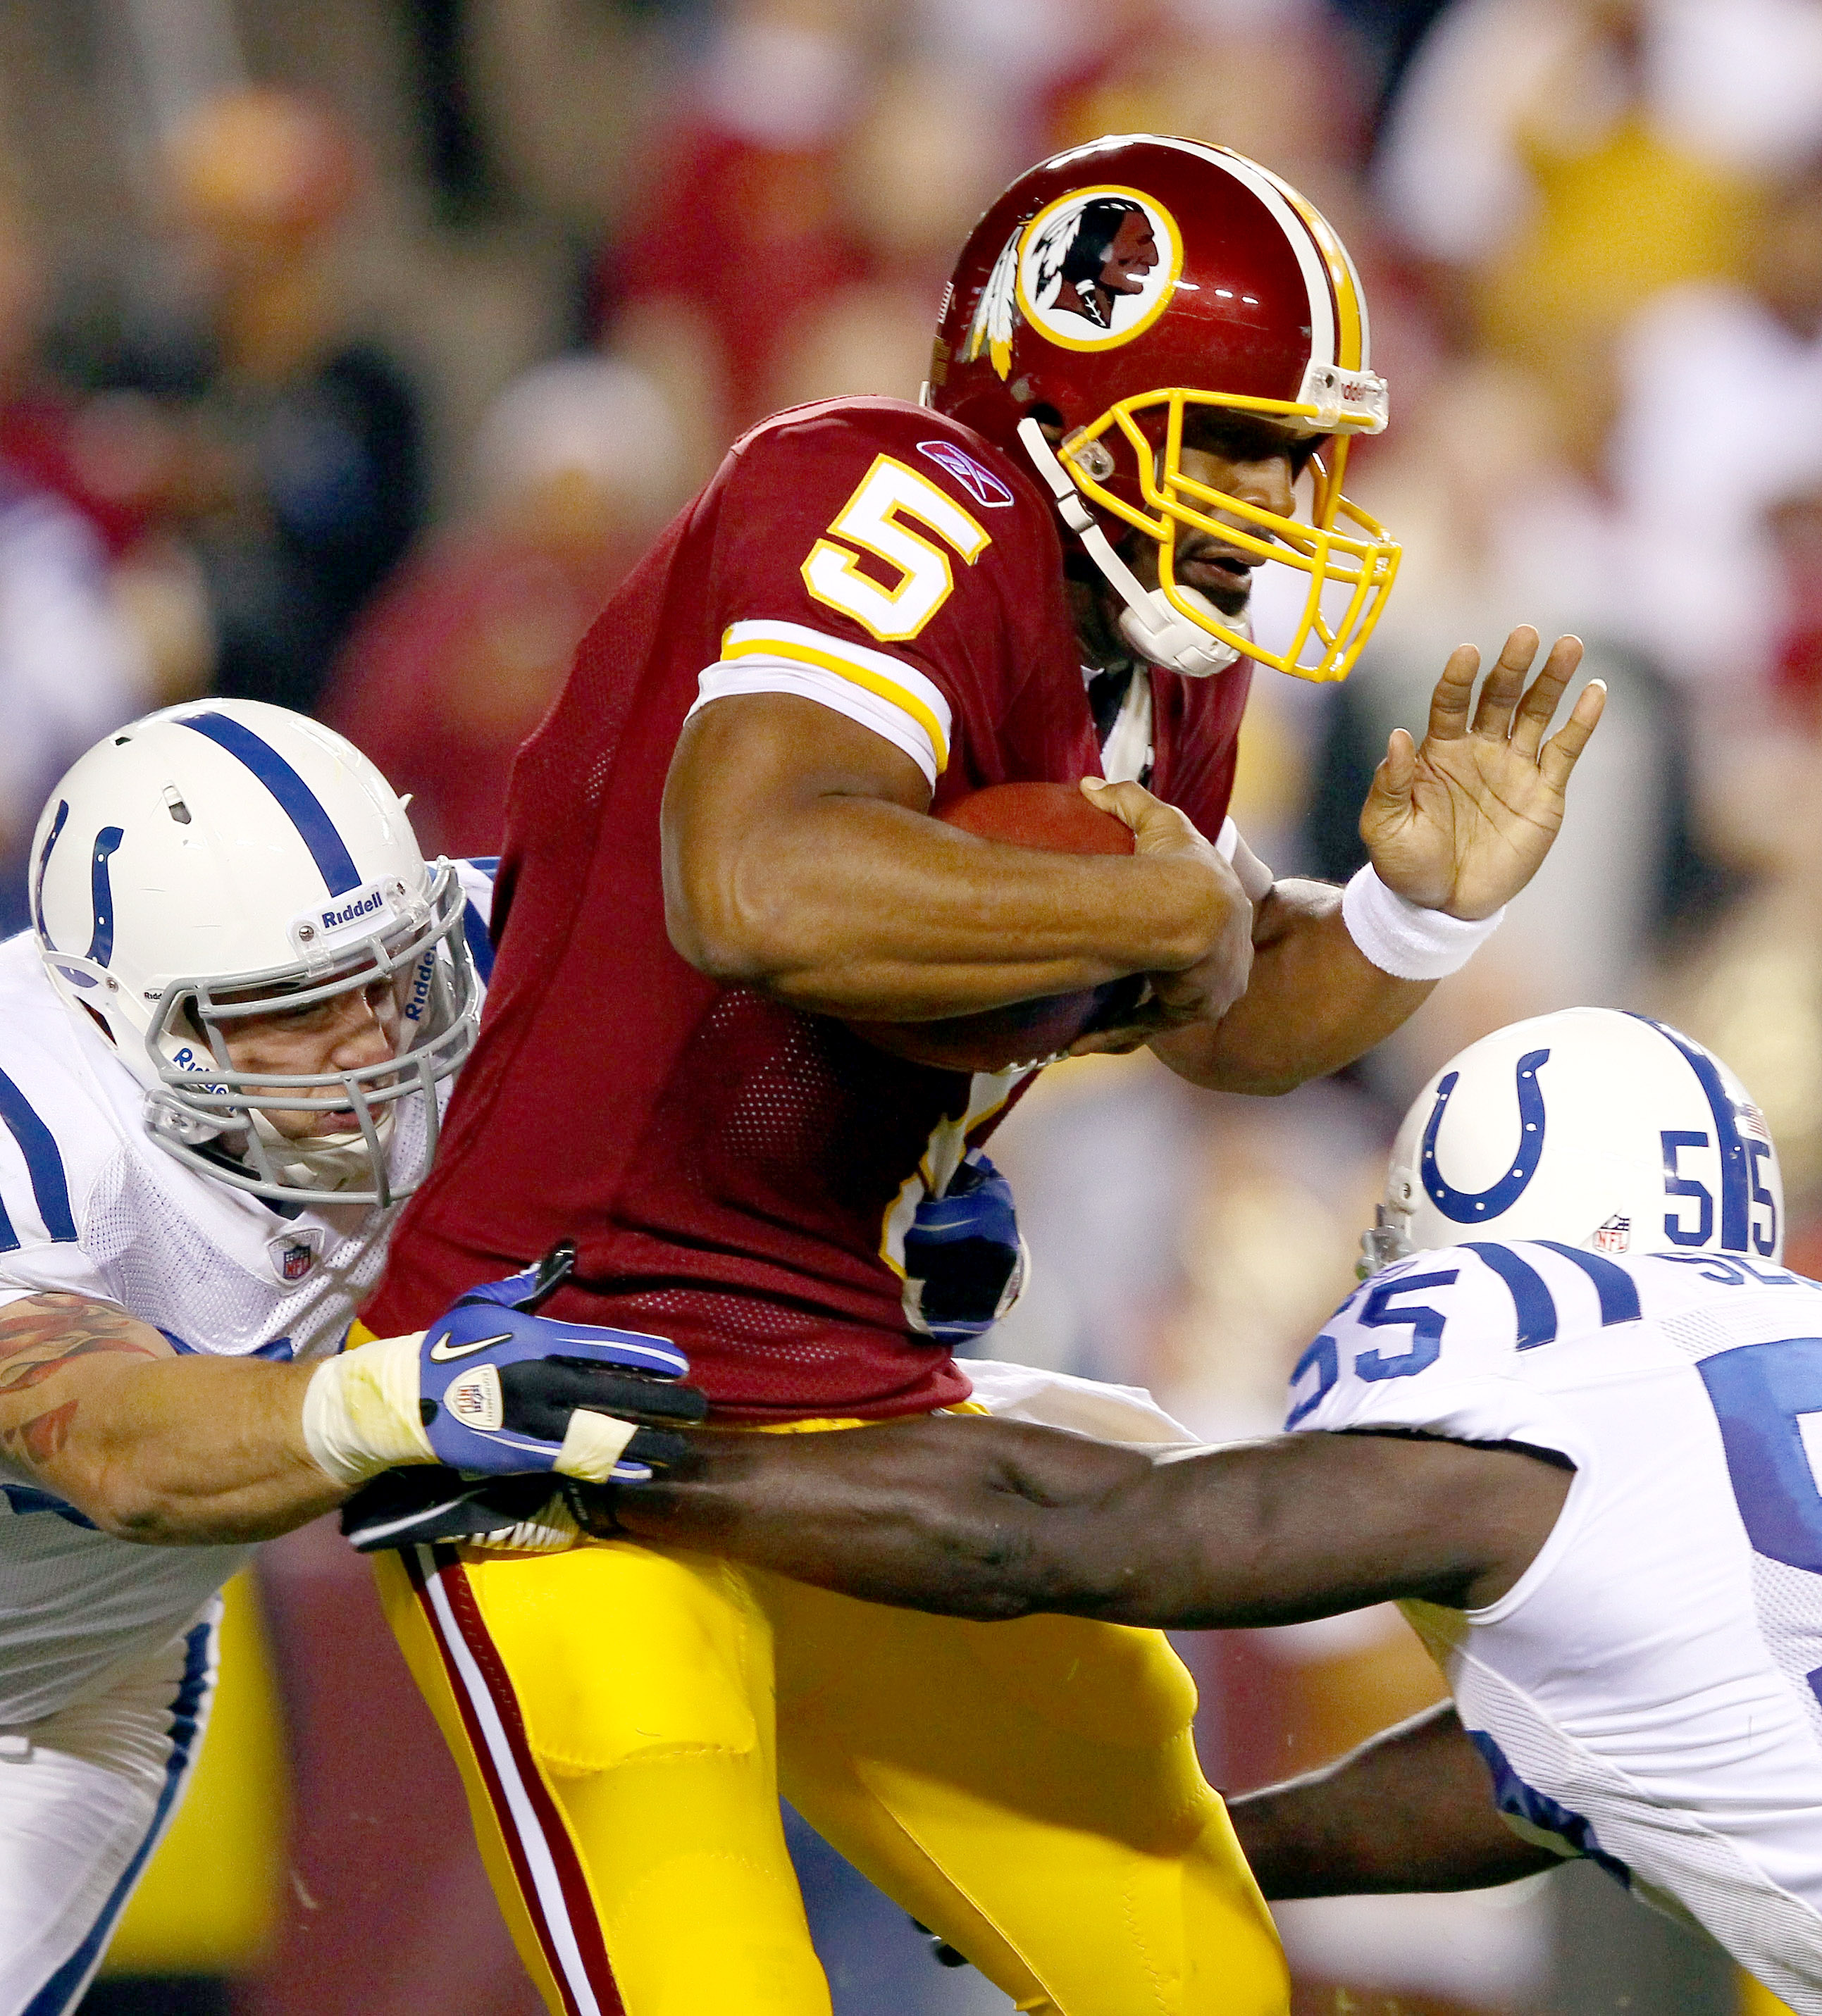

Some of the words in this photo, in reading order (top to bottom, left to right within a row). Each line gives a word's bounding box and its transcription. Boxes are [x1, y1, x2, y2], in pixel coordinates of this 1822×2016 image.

[800, 453, 992, 642] 5
[322, 892, 383, 928] Riddell
[1594, 1231, 1628, 1252] NFL
